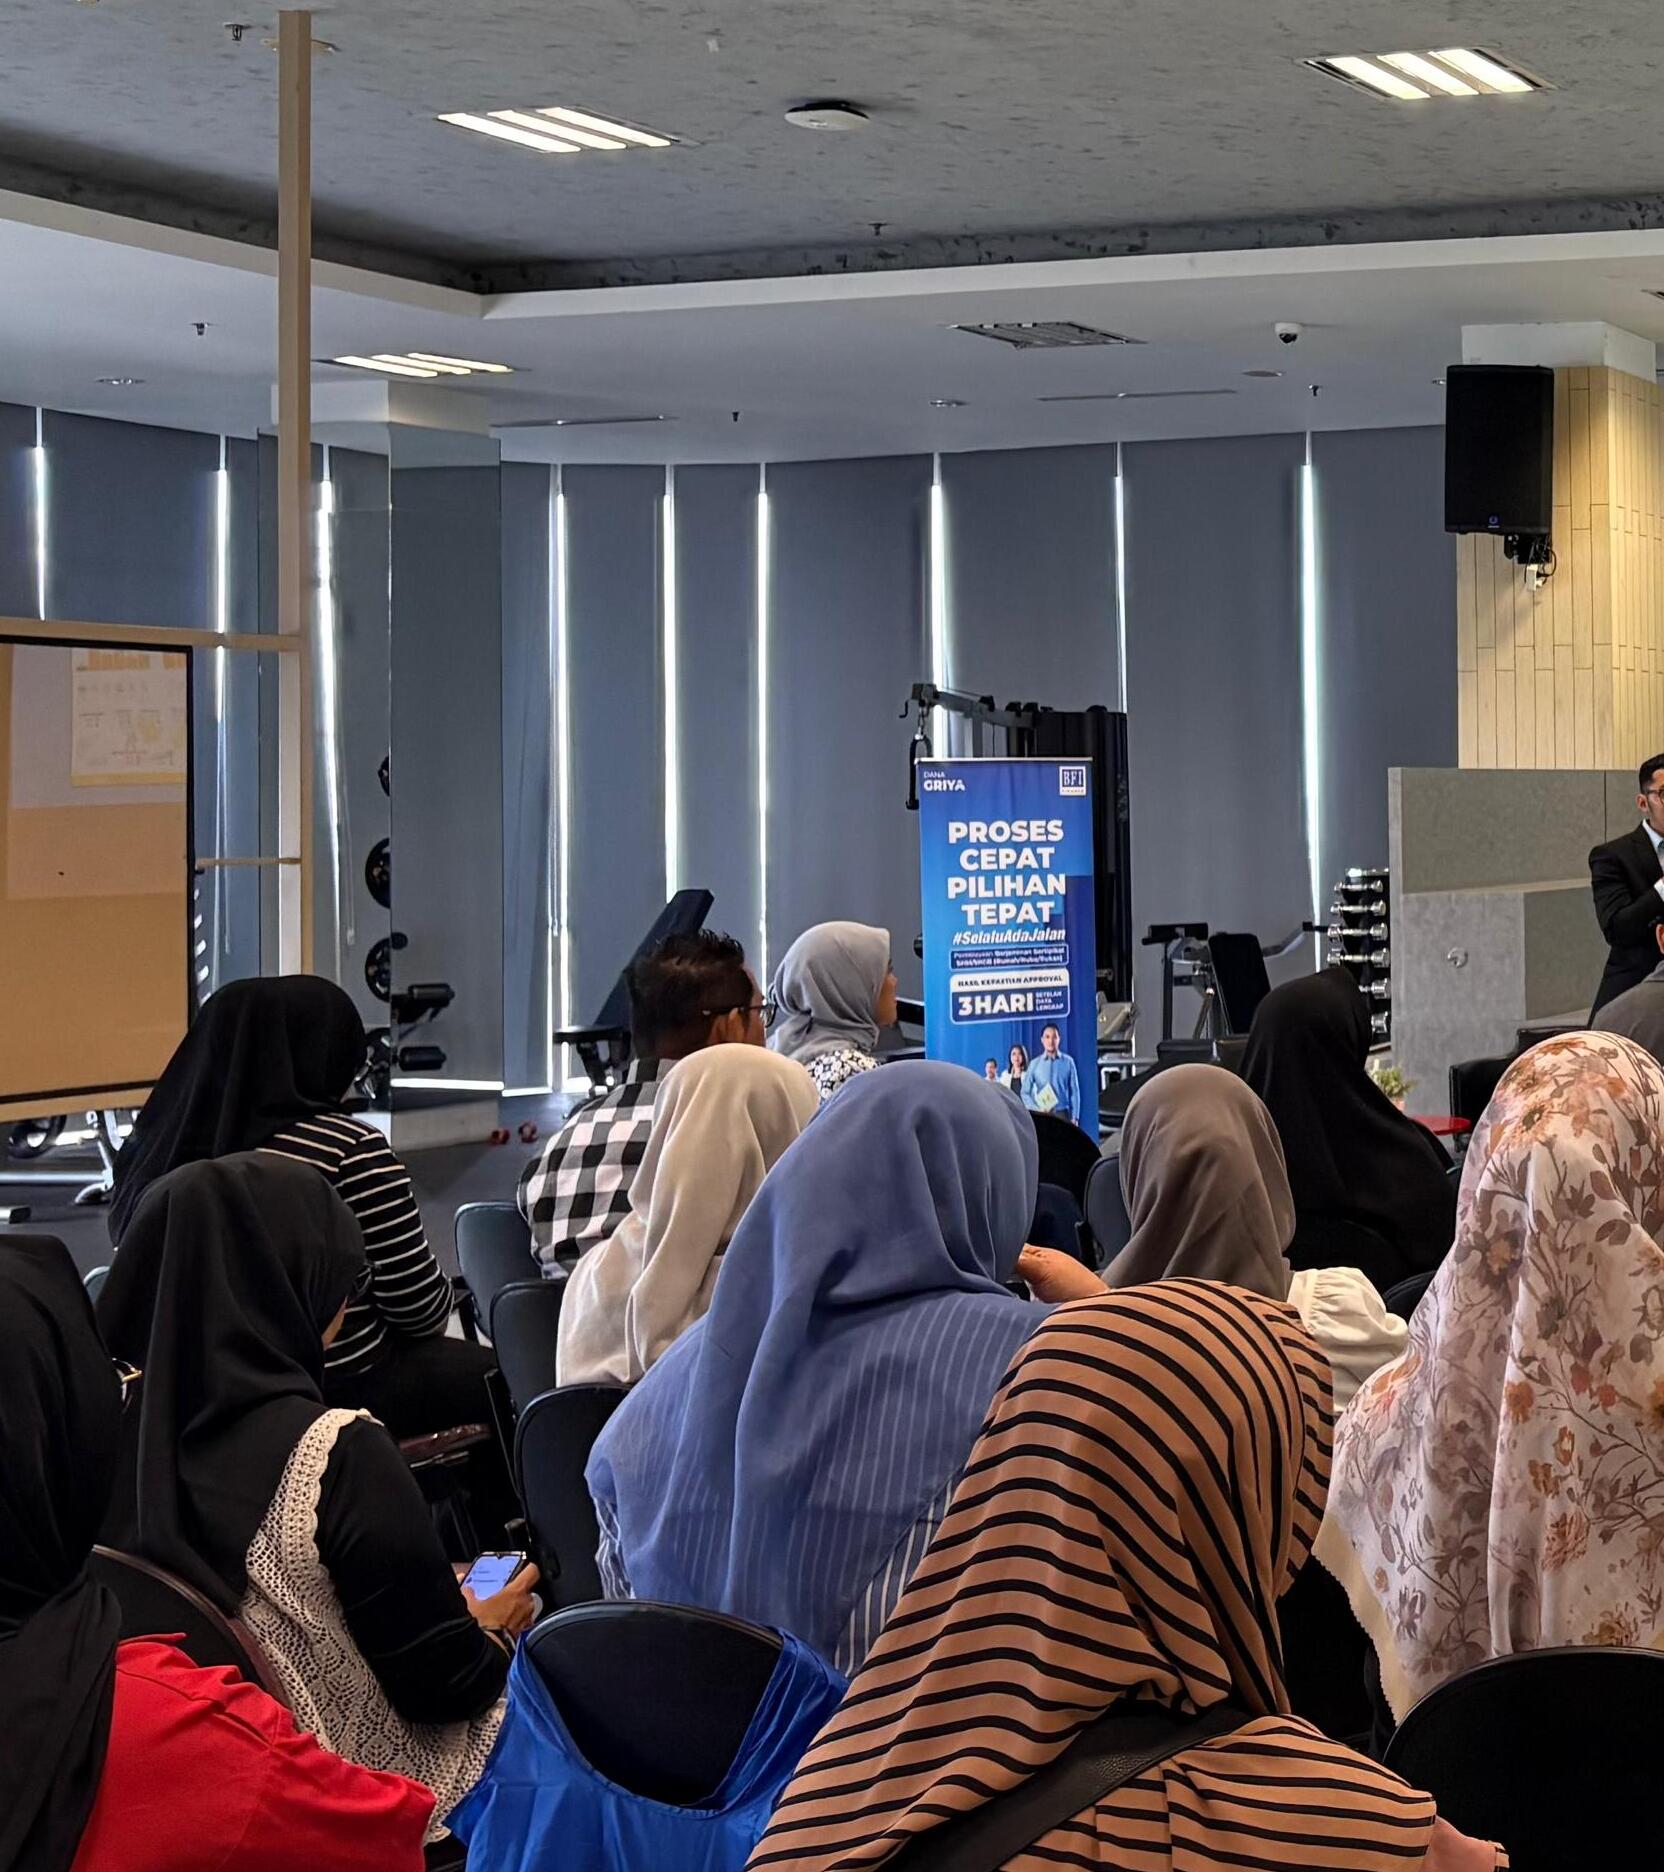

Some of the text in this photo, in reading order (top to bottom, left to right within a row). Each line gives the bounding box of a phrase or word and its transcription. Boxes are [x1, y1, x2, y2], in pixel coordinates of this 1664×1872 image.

[923, 779, 966, 792] GRIYA
[1063, 770, 1083, 786] BFI
[948, 819, 1065, 844] PROSES
[959, 847, 1056, 871] CEPAT
[947, 873, 1066, 899] PILIHAN
[960, 901, 1056, 926] TEPAT
[952, 927, 1066, 946] #SelaluAdaJalan
[1023, 975, 1063, 984] APPROVAL
